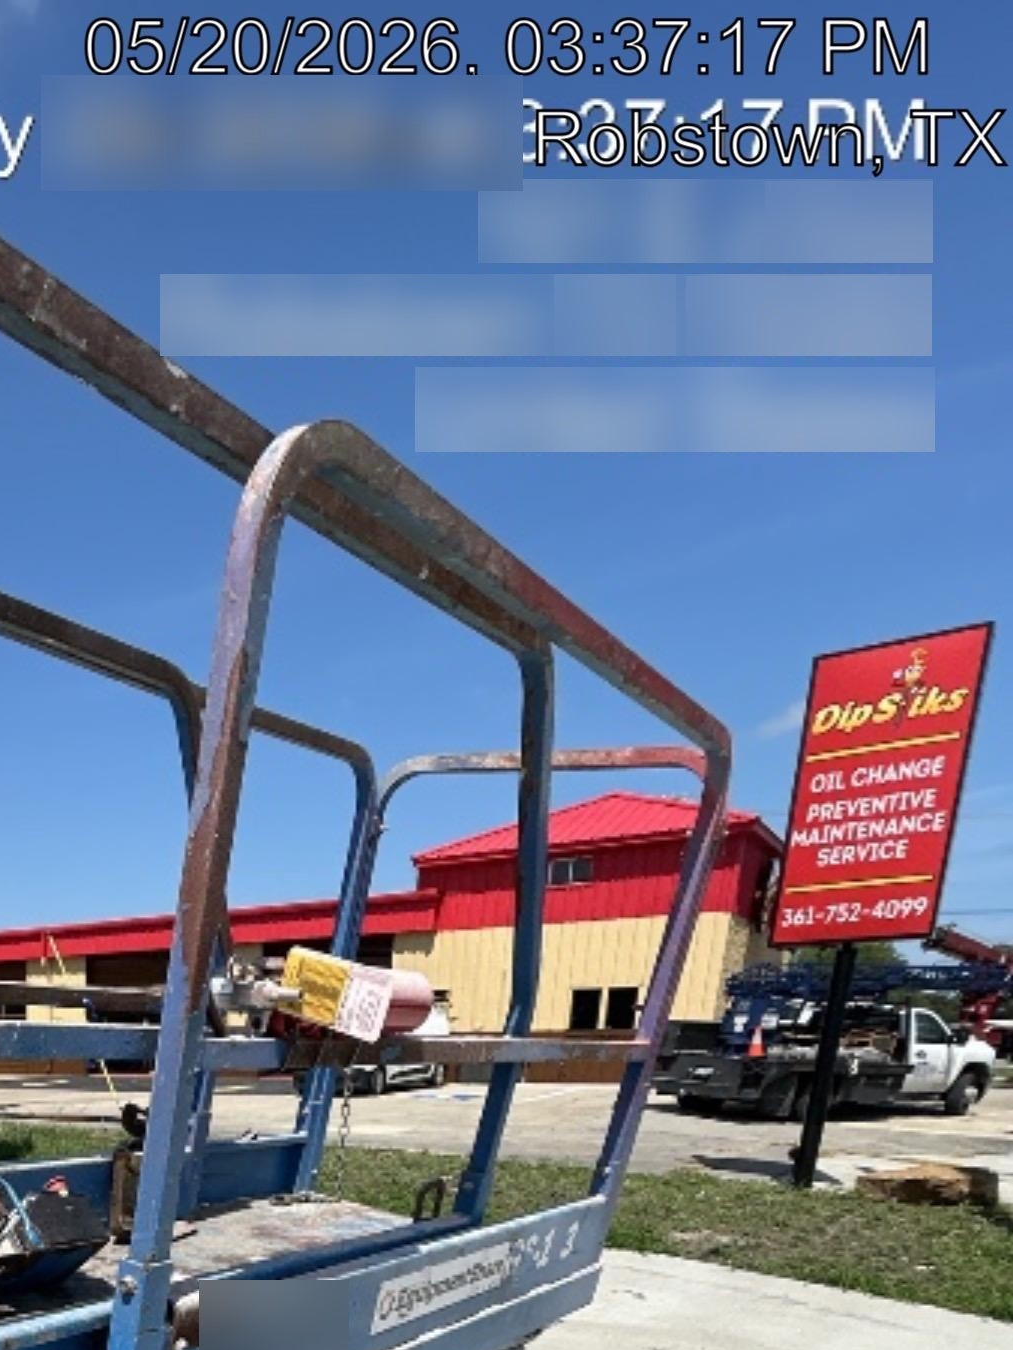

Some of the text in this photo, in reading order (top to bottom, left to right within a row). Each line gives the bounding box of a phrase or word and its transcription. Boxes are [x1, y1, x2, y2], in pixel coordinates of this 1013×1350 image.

[810, 755, 945, 794] OIL CHANGE
[806, 788, 937, 823] PREVENTIVE
[791, 811, 948, 847] MAINTENANCE
[816, 839, 909, 867] SERVICE
[781, 896, 928, 928] 361-752-4099
